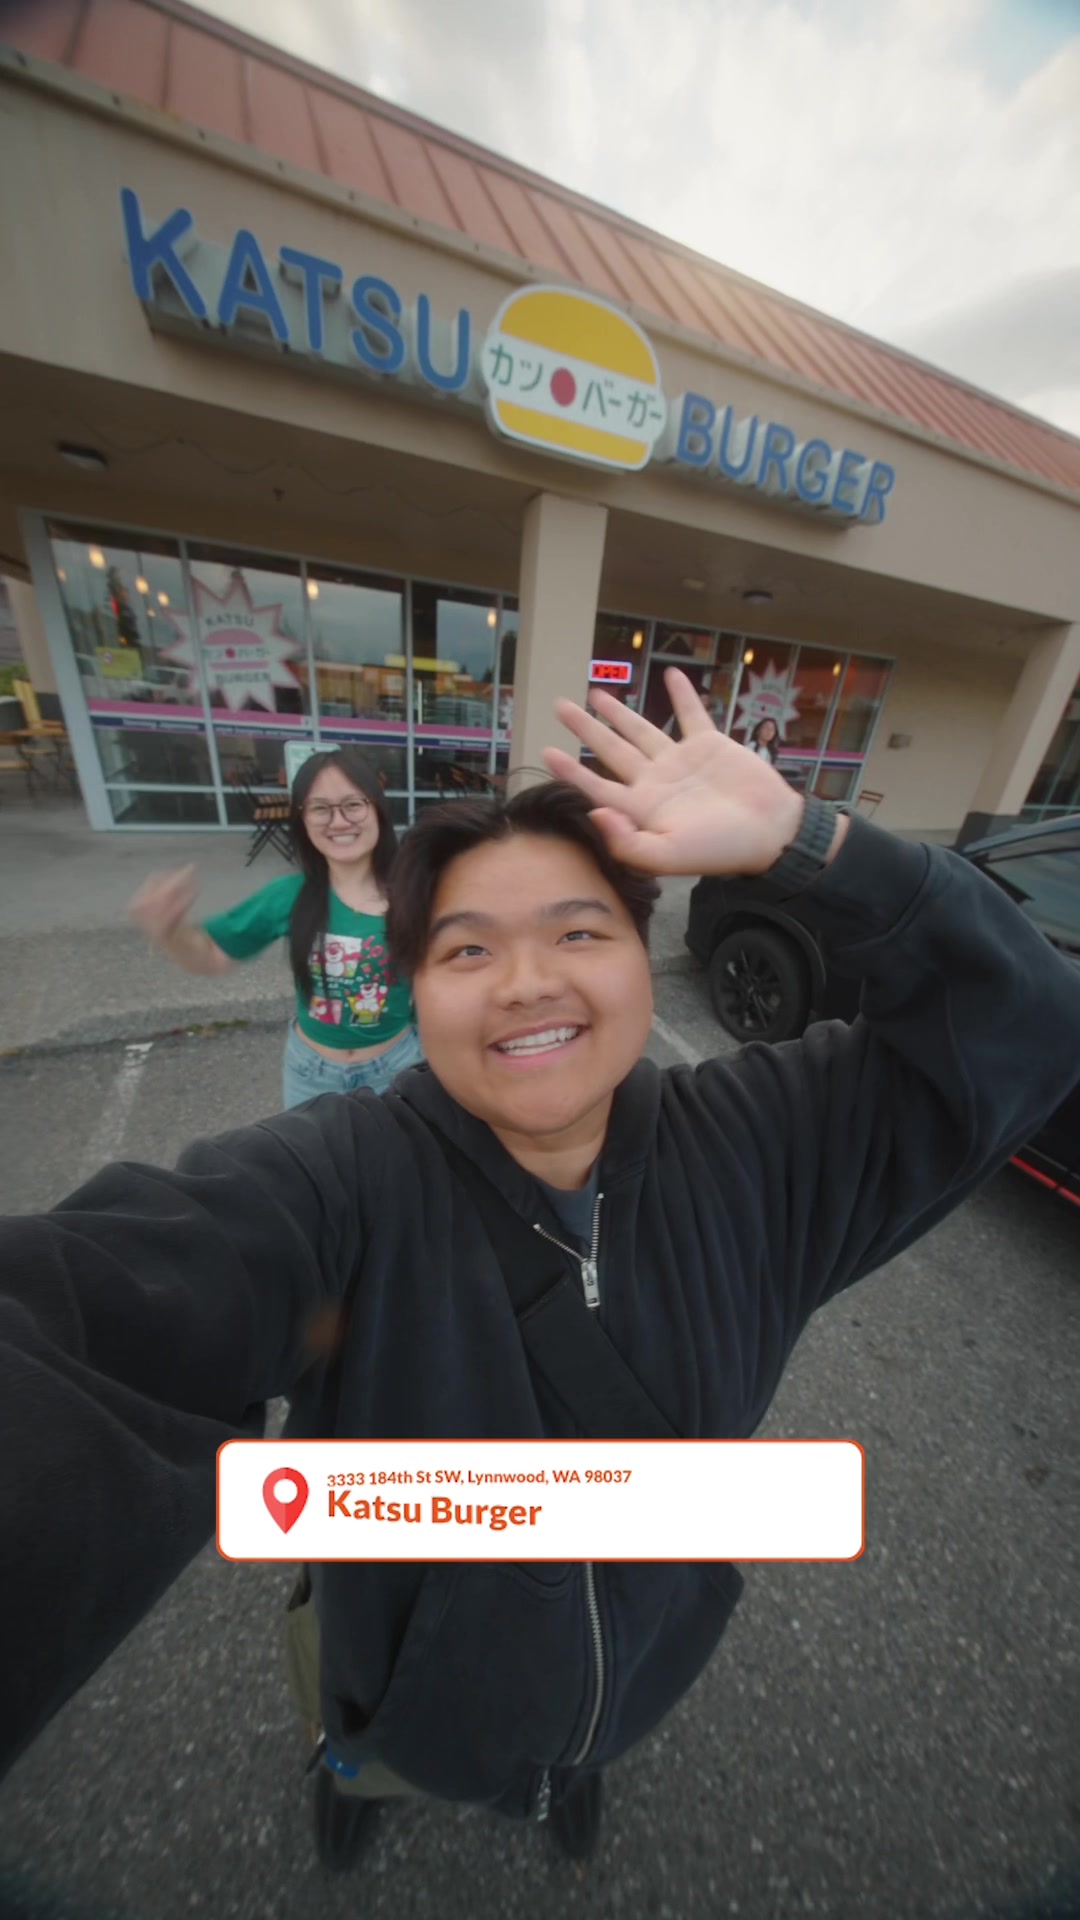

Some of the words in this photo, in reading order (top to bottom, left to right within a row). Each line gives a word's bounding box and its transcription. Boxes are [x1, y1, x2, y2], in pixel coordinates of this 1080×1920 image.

[120, 186, 472, 392] KATSU
[489, 343, 543, 392] カツ
[581, 377, 663, 429] バーガー
[674, 390, 897, 524] BURGER
[204, 612, 256, 629] KATSU
[592, 663, 629, 681] OPEN
